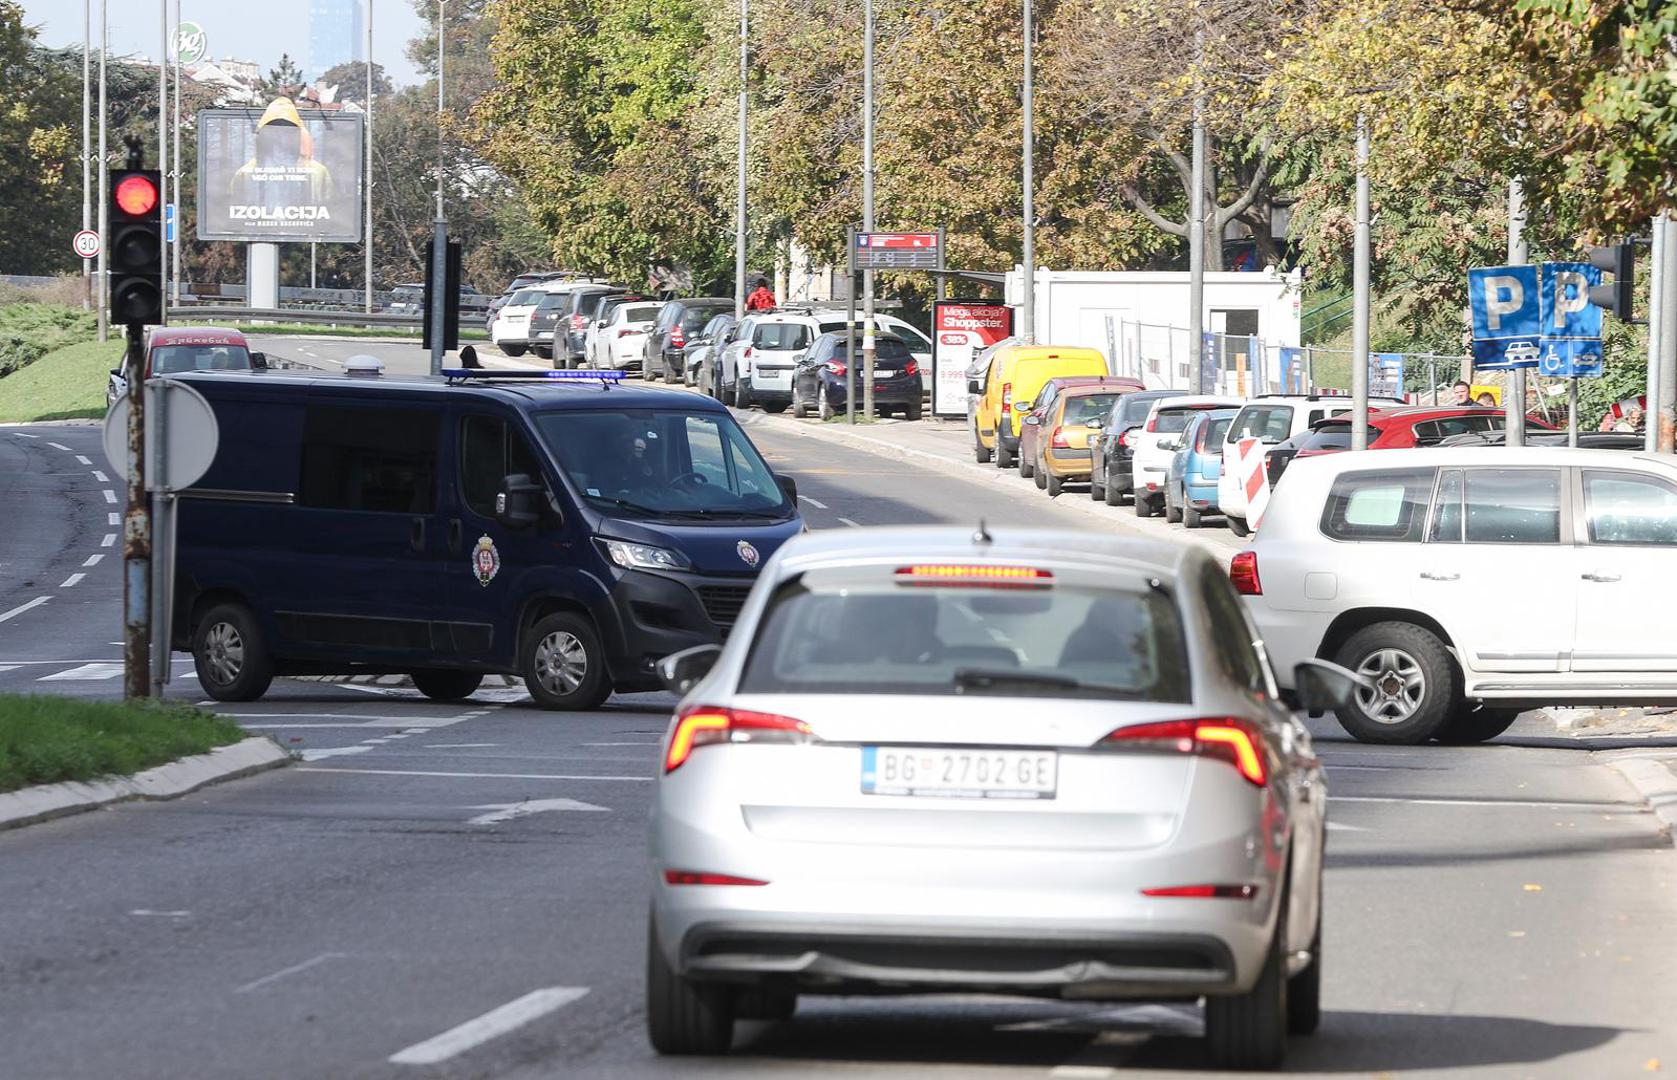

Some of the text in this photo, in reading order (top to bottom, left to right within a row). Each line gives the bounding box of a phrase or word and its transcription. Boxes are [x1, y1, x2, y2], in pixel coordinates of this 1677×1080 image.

[229, 205, 331, 220] IZOLACIJA
[80, 237, 96, 251] 30
[1484, 275, 1524, 330] P
[1554, 271, 1589, 328] P
[943, 306, 1006, 319] Mega akcija?
[885, 754, 1049, 785] BG 2702 GE
